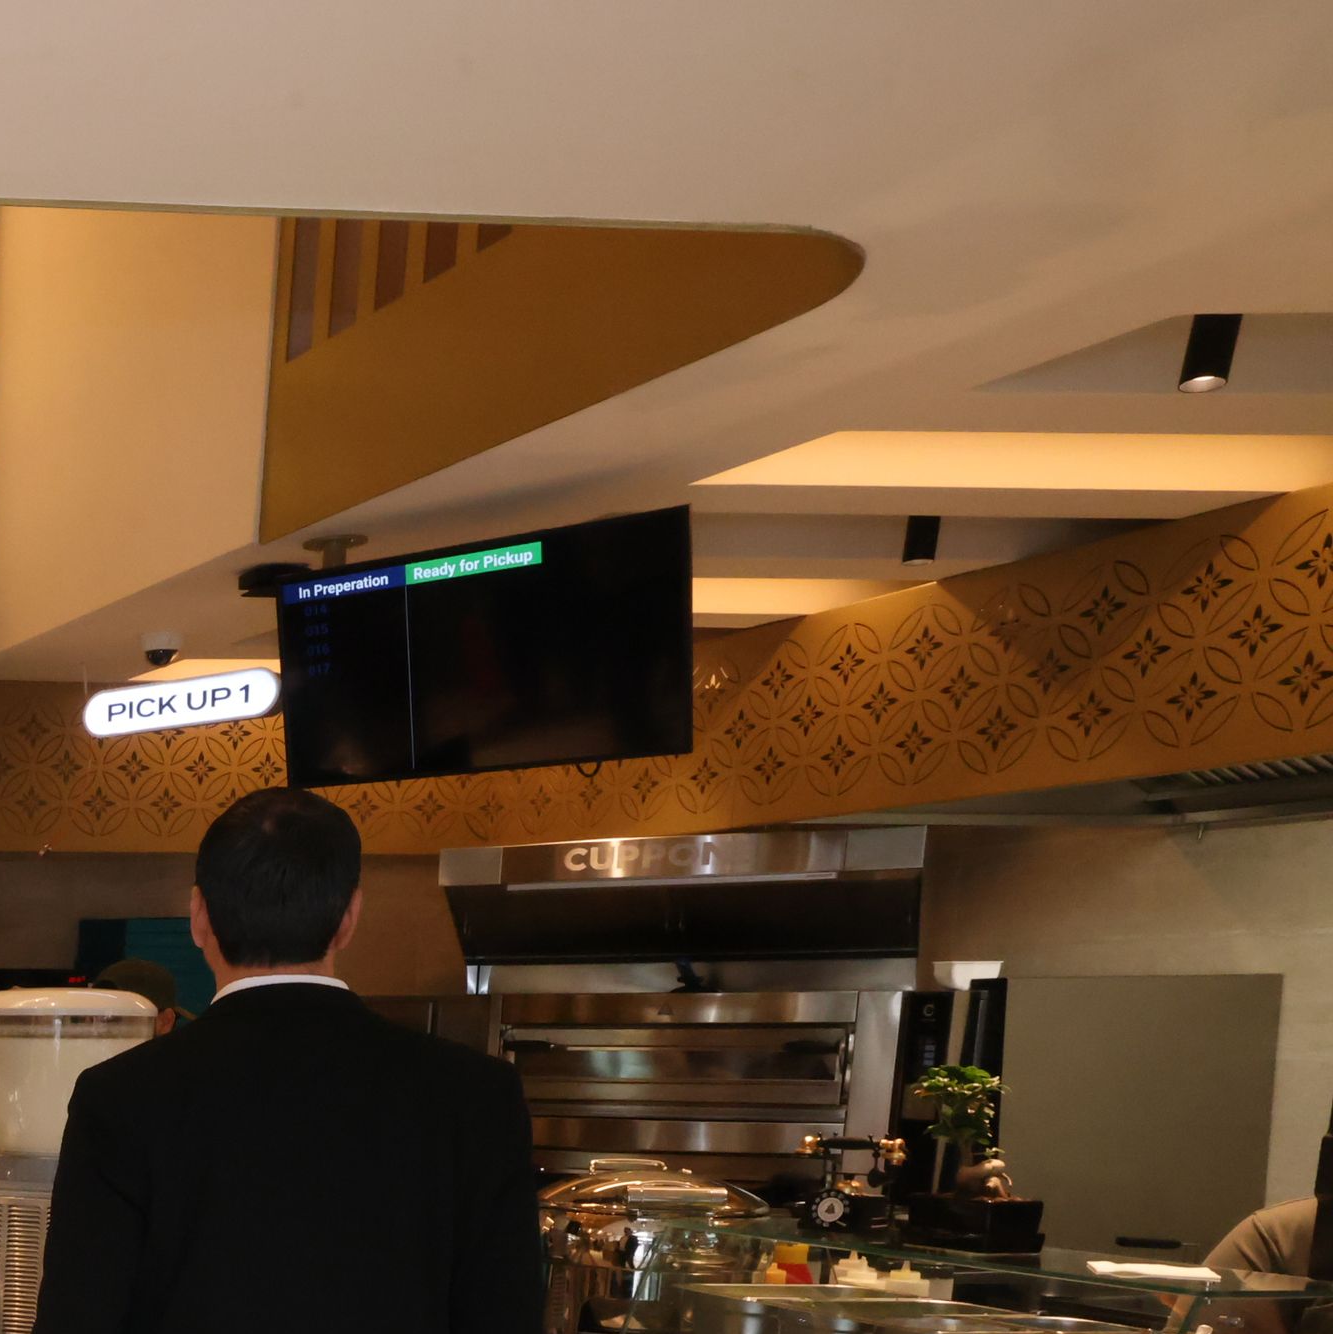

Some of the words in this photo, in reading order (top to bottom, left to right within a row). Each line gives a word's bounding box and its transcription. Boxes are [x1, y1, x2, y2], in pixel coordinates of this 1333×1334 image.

[413, 565, 456, 580] Ready
[459, 559, 479, 572] for
[483, 551, 533, 569] Pickup
[299, 587, 310, 599] In
[314, 574, 389, 597] Preperation
[108, 695, 177, 722] PICK
[187, 687, 231, 711] UP
[239, 684, 250, 703] 1
[564, 841, 751, 871] CUPPON
